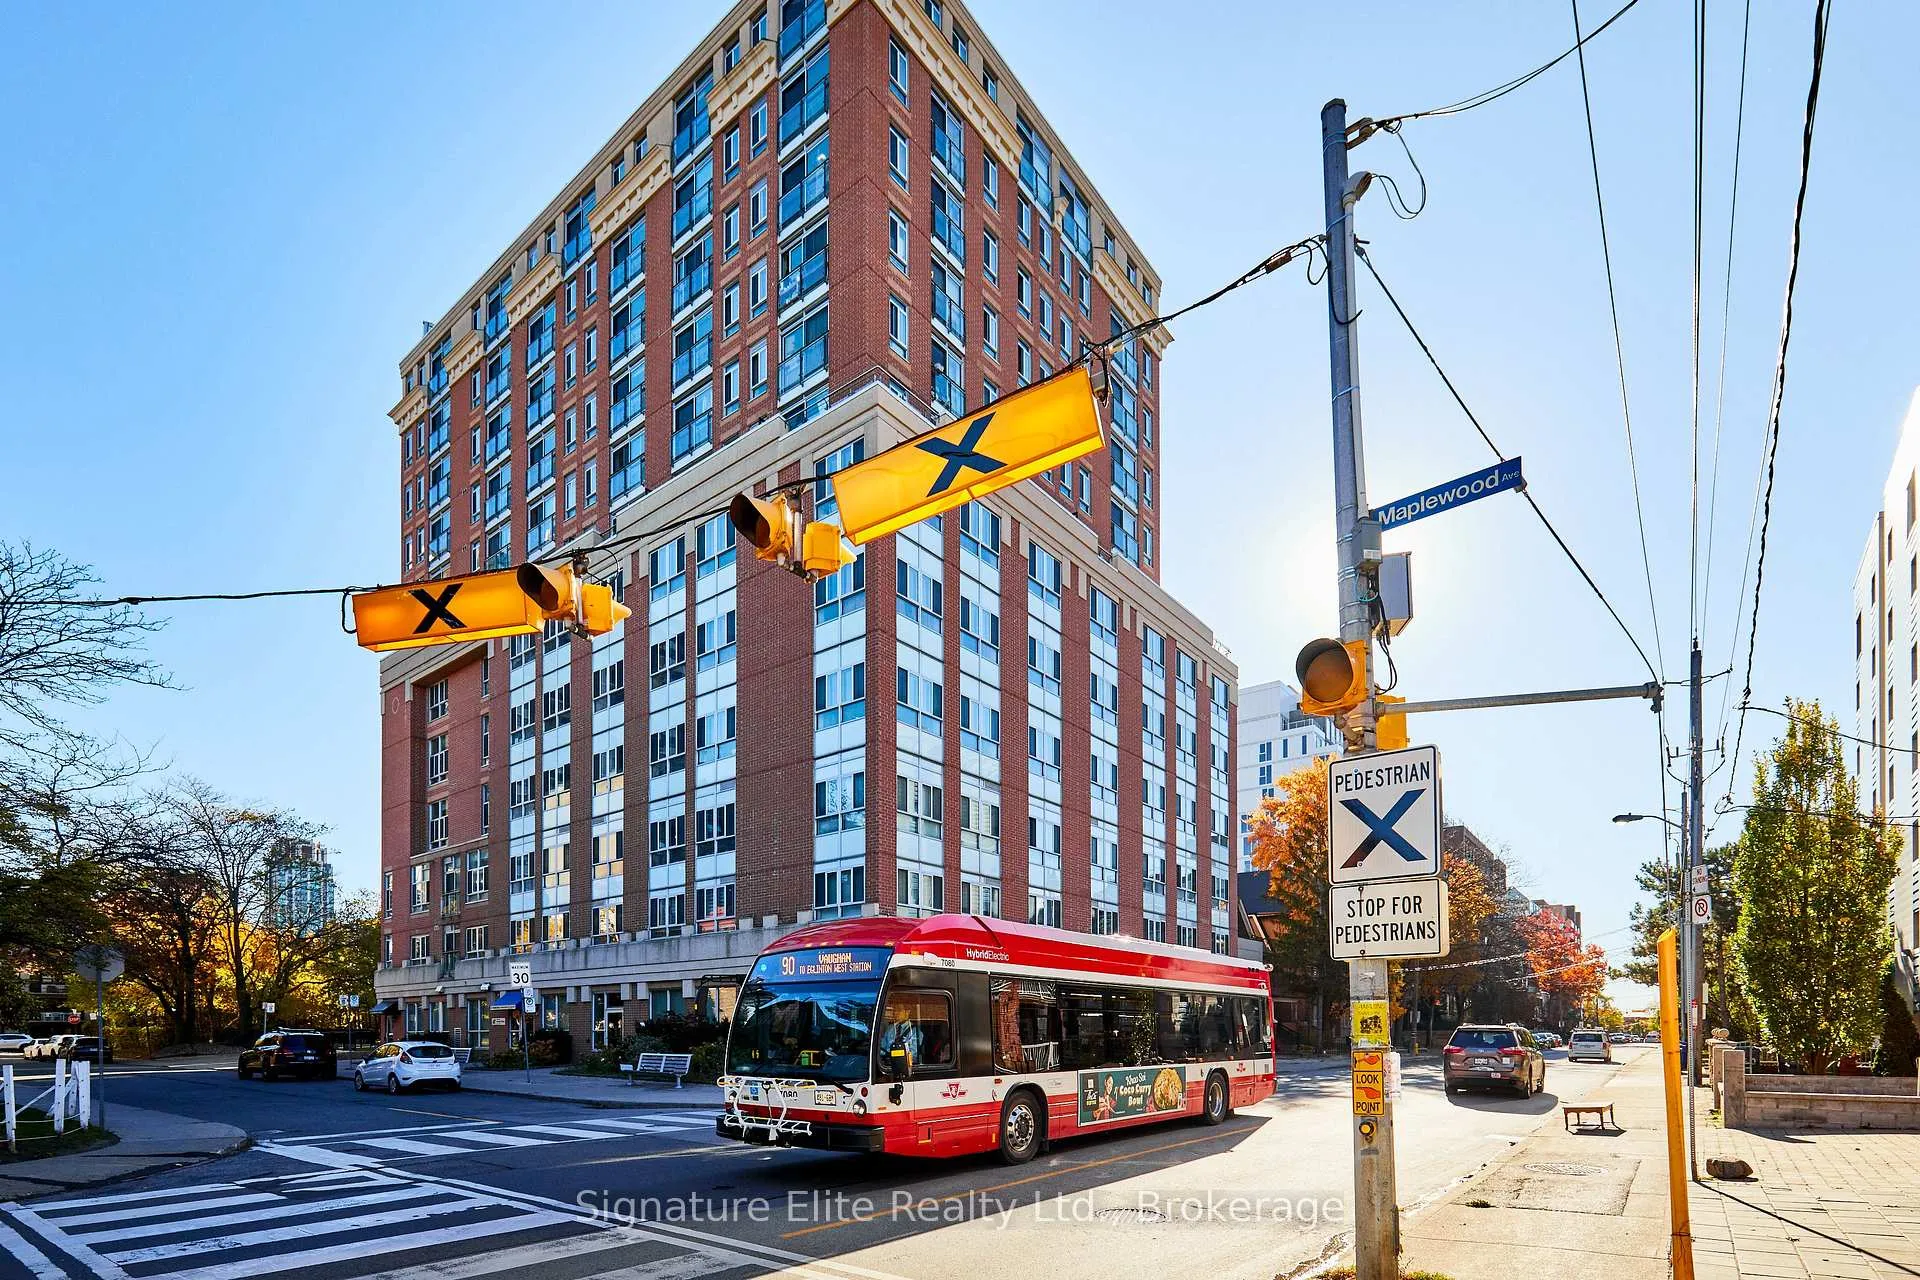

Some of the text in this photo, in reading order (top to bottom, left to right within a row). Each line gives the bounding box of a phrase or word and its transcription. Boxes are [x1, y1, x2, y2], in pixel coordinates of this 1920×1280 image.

[1378, 469, 1520, 525] Maplewood Ave
[1335, 761, 1430, 793] PEDESTRIAN
[1347, 895, 1423, 918] STOP FOR
[1335, 920, 1436, 945] PEDESTRIANS
[818, 952, 852, 963] VAUGHAN
[966, 948, 1010, 961] HybridElectric
[782, 956, 796, 976] 90
[799, 964, 806, 975] TO
[833, 962, 847, 973] WEST
[849, 961, 872, 972] STATION
[941, 959, 955, 967] 7080
[513, 972, 529, 984] 30
[1356, 1074, 1379, 1084] LOOK
[1120, 1084, 1152, 1095] Coco Curry
[1128, 1095, 1143, 1106] Bowl
[1356, 1101, 1381, 1112] POINT
